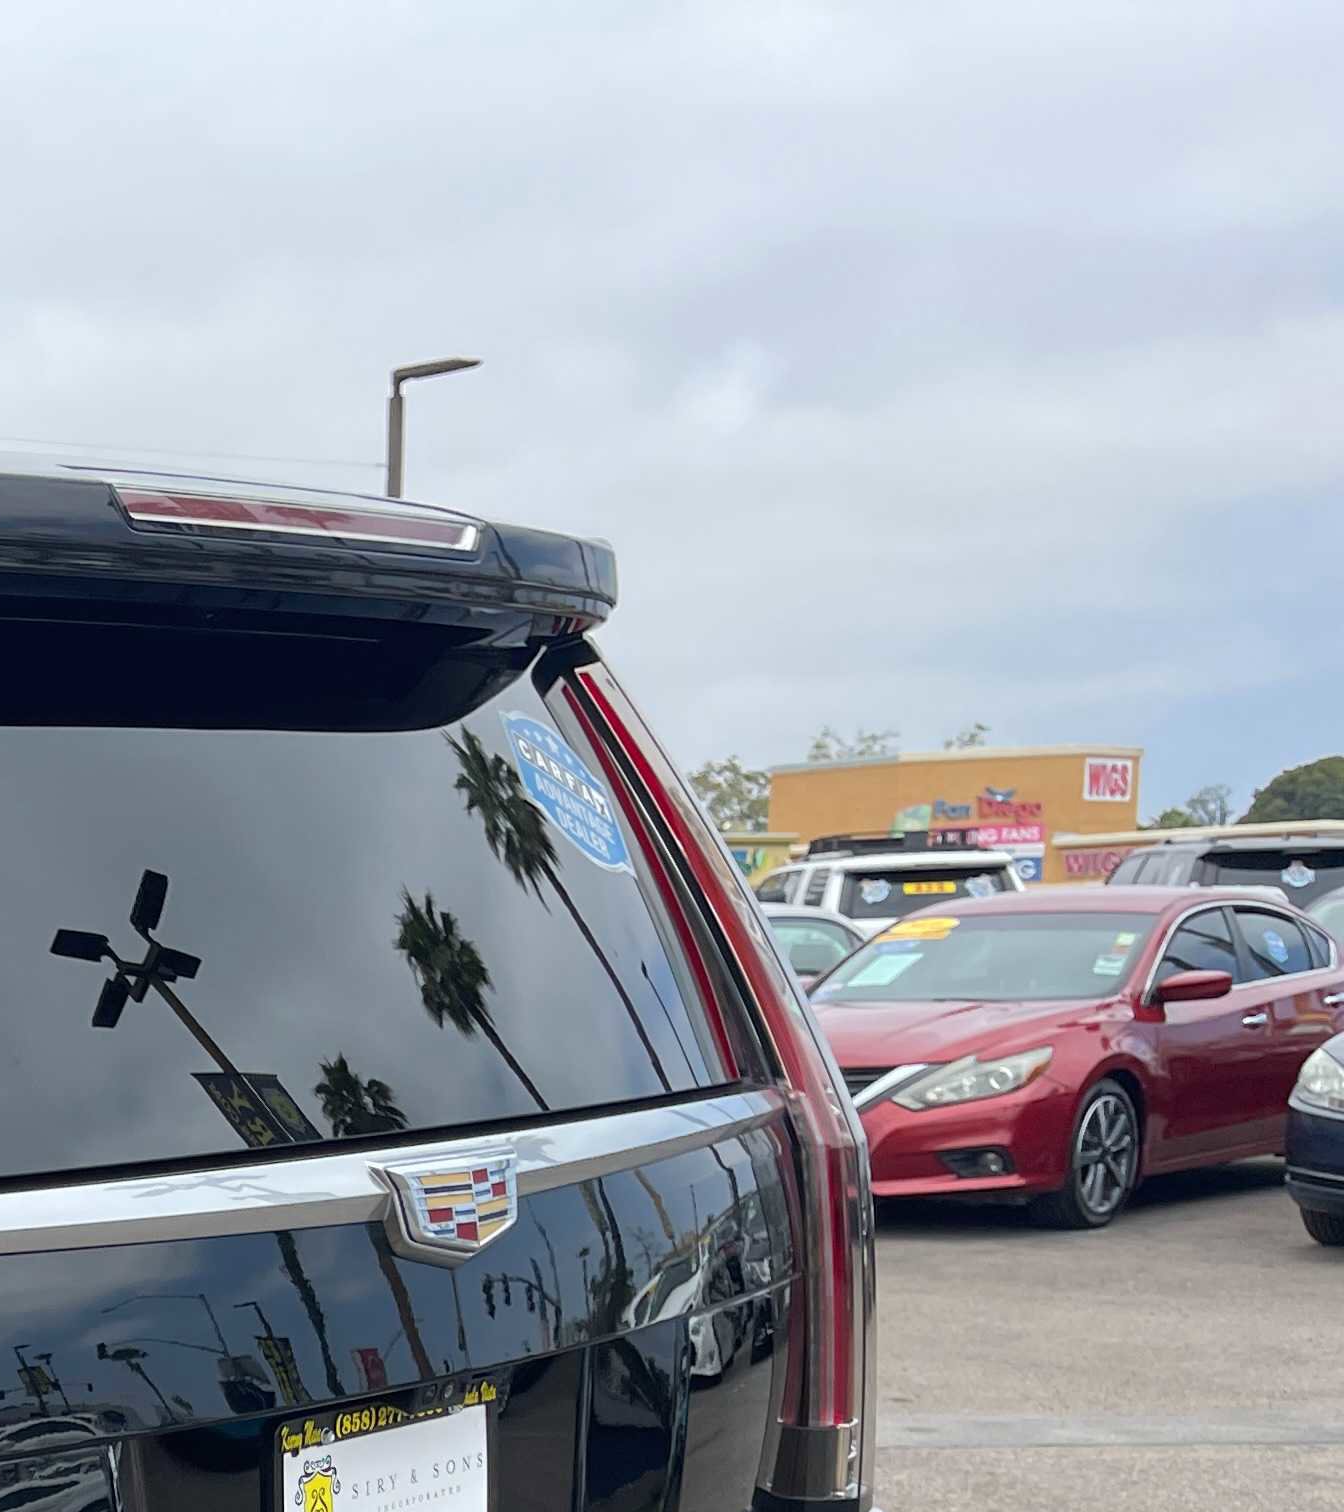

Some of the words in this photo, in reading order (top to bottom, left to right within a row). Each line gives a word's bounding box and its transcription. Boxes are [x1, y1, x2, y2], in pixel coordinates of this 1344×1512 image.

[1087, 761, 1129, 799] WIGS
[933, 800, 971, 818] Fan
[977, 797, 1042, 822] Diego
[1001, 826, 1041, 844] FANS
[351, 1473, 398, 1500] SIRY
[410, 1468, 419, 1484] &
[432, 1452, 485, 1479] SONS
